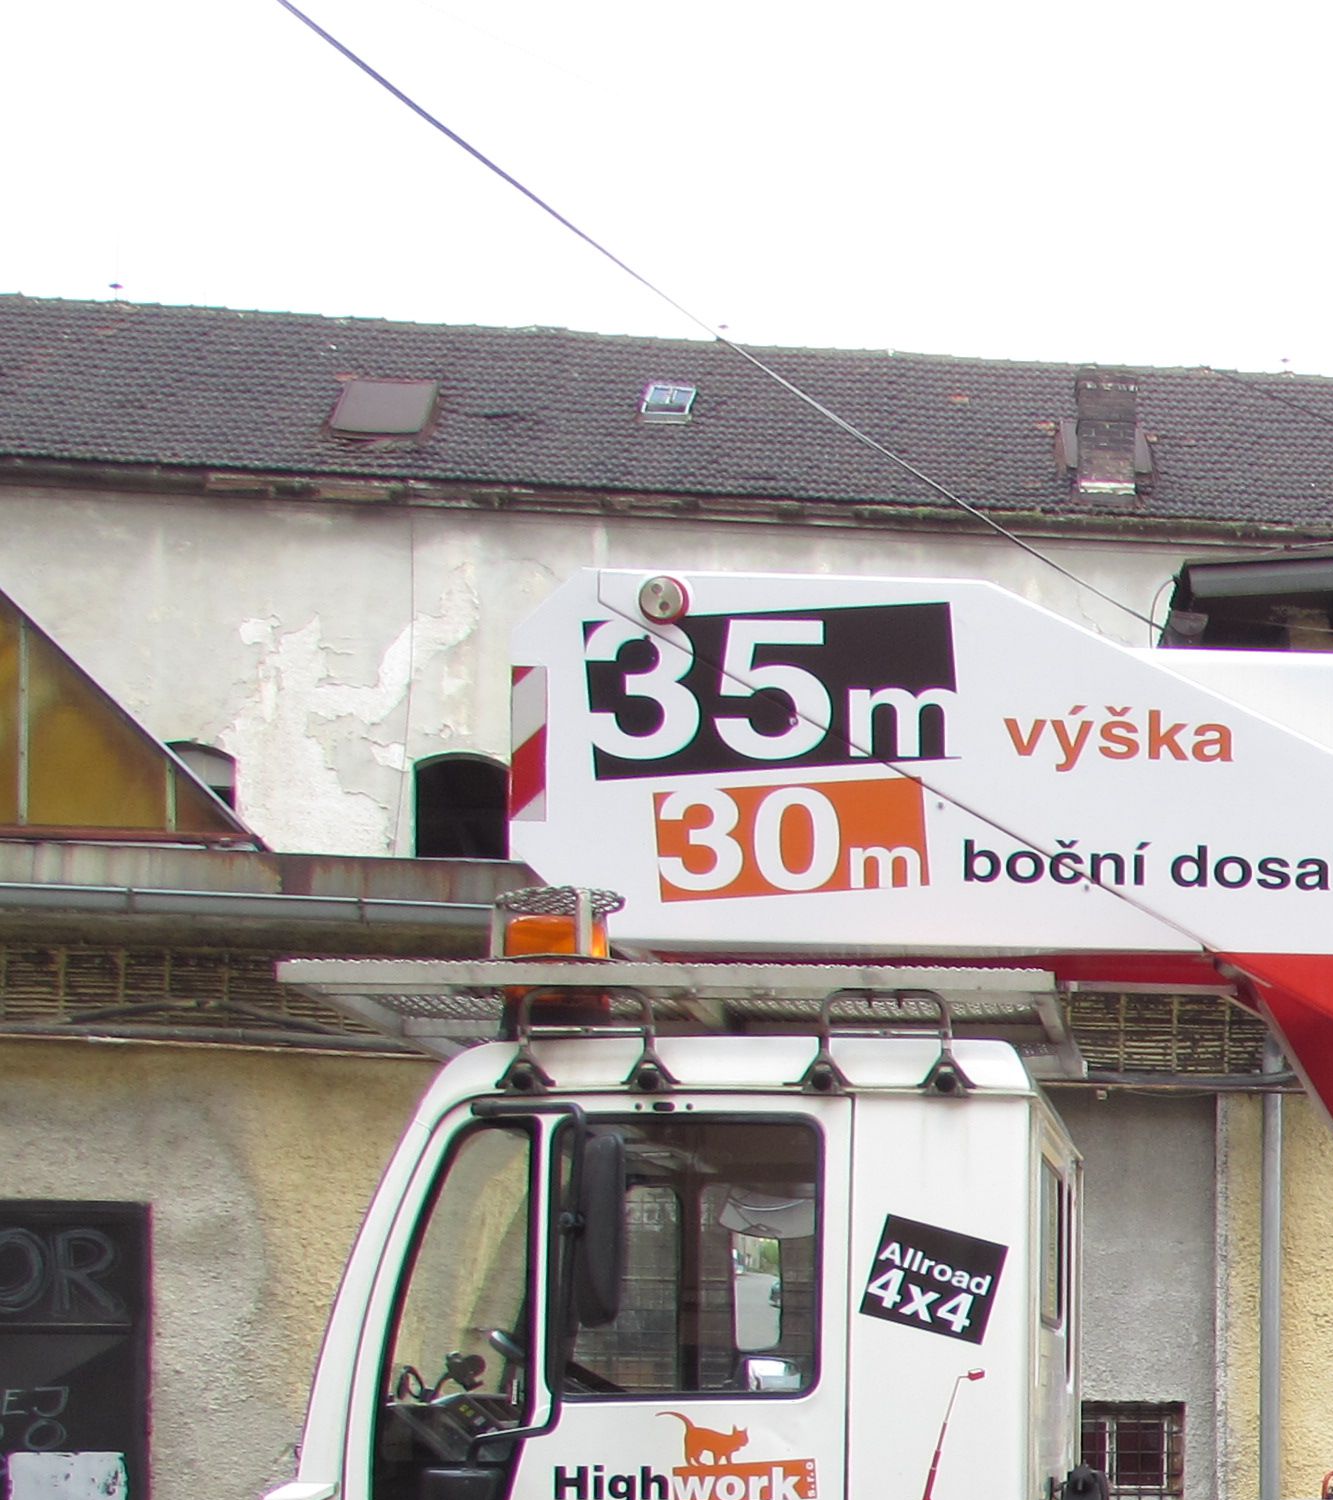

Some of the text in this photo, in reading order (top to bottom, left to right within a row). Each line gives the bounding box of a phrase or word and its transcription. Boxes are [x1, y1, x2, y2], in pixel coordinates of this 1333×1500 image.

[585, 619, 1234, 771] 35m výška
[658, 787, 921, 892] 30m
[963, 839, 1152, 885] boční
[866, 1267, 975, 1334] 4x4
[878, 1242, 992, 1296] Allroad
